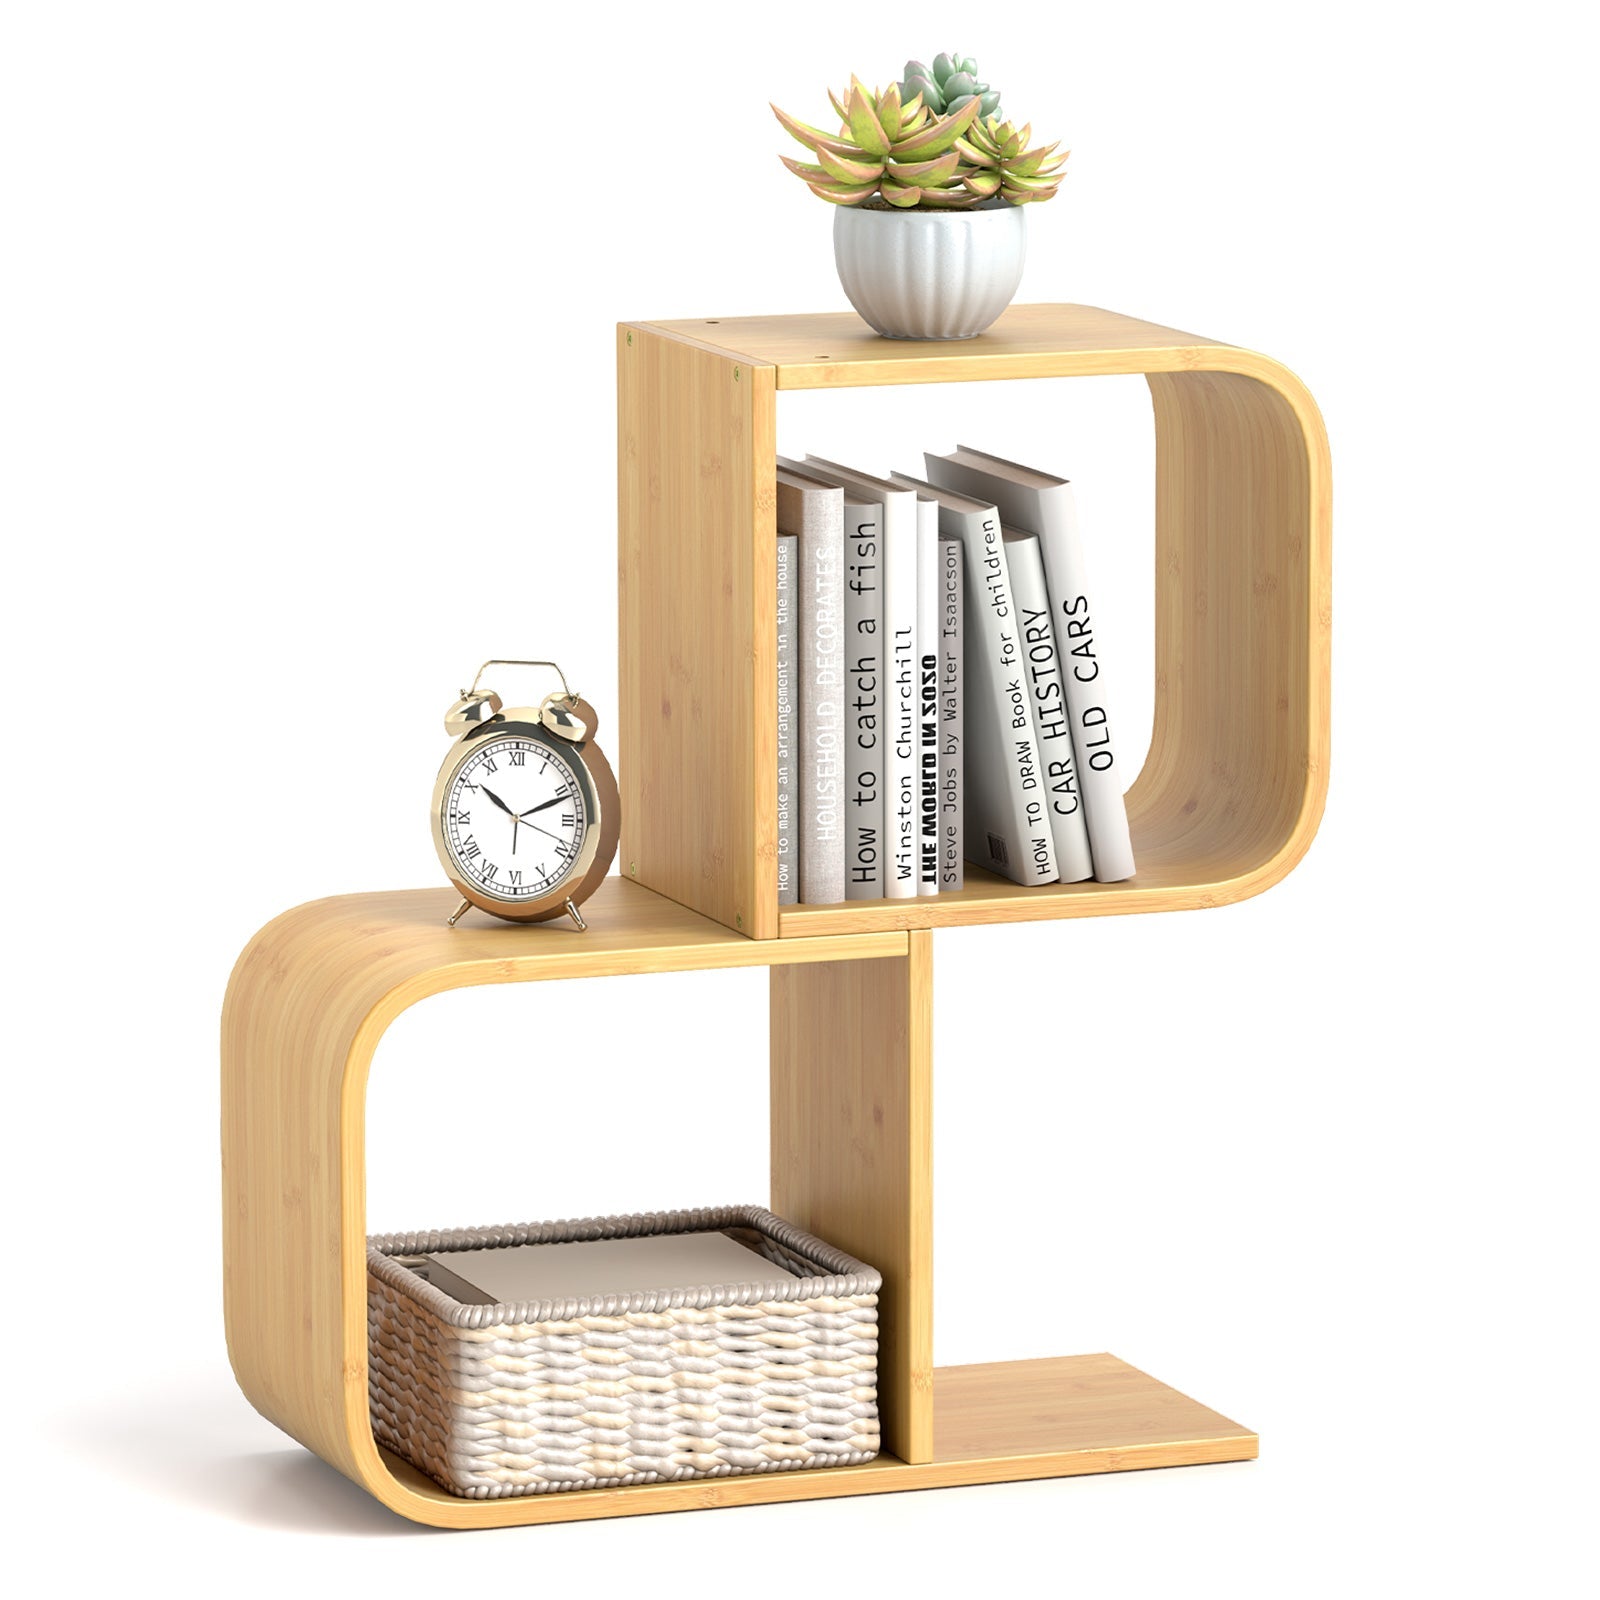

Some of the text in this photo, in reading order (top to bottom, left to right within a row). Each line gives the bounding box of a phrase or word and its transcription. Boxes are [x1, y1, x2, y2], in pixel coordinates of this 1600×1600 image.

[816, 547, 837, 840] HOUSEHOLD DECORATES
[1062, 595, 1114, 772] OLD CARS
[849, 523, 876, 882] How to catch a fish
[982, 519, 1051, 875] HOW TO DRAW Book for children
[776, 545, 791, 891] How to make an arrangement in the house
[942, 545, 959, 883] Steve Jobs by Walter Isaacson
[1022, 609, 1078, 815] CAR HISTORY
[508, 751, 525, 766] XII
[896, 626, 912, 880] Winston Churchill
[482, 758, 498, 776] XI
[539, 762, 548, 775] I
[464, 780, 479, 795] X
[554, 784, 568, 797] II
[458, 811, 470, 825] IX
[561, 814, 574, 827] III
[463, 834, 481, 860] VIII
[554, 839, 569, 858] IV
[481, 859, 499, 880] VII
[509, 870, 522, 885] VI
[535, 863, 546, 878] V
